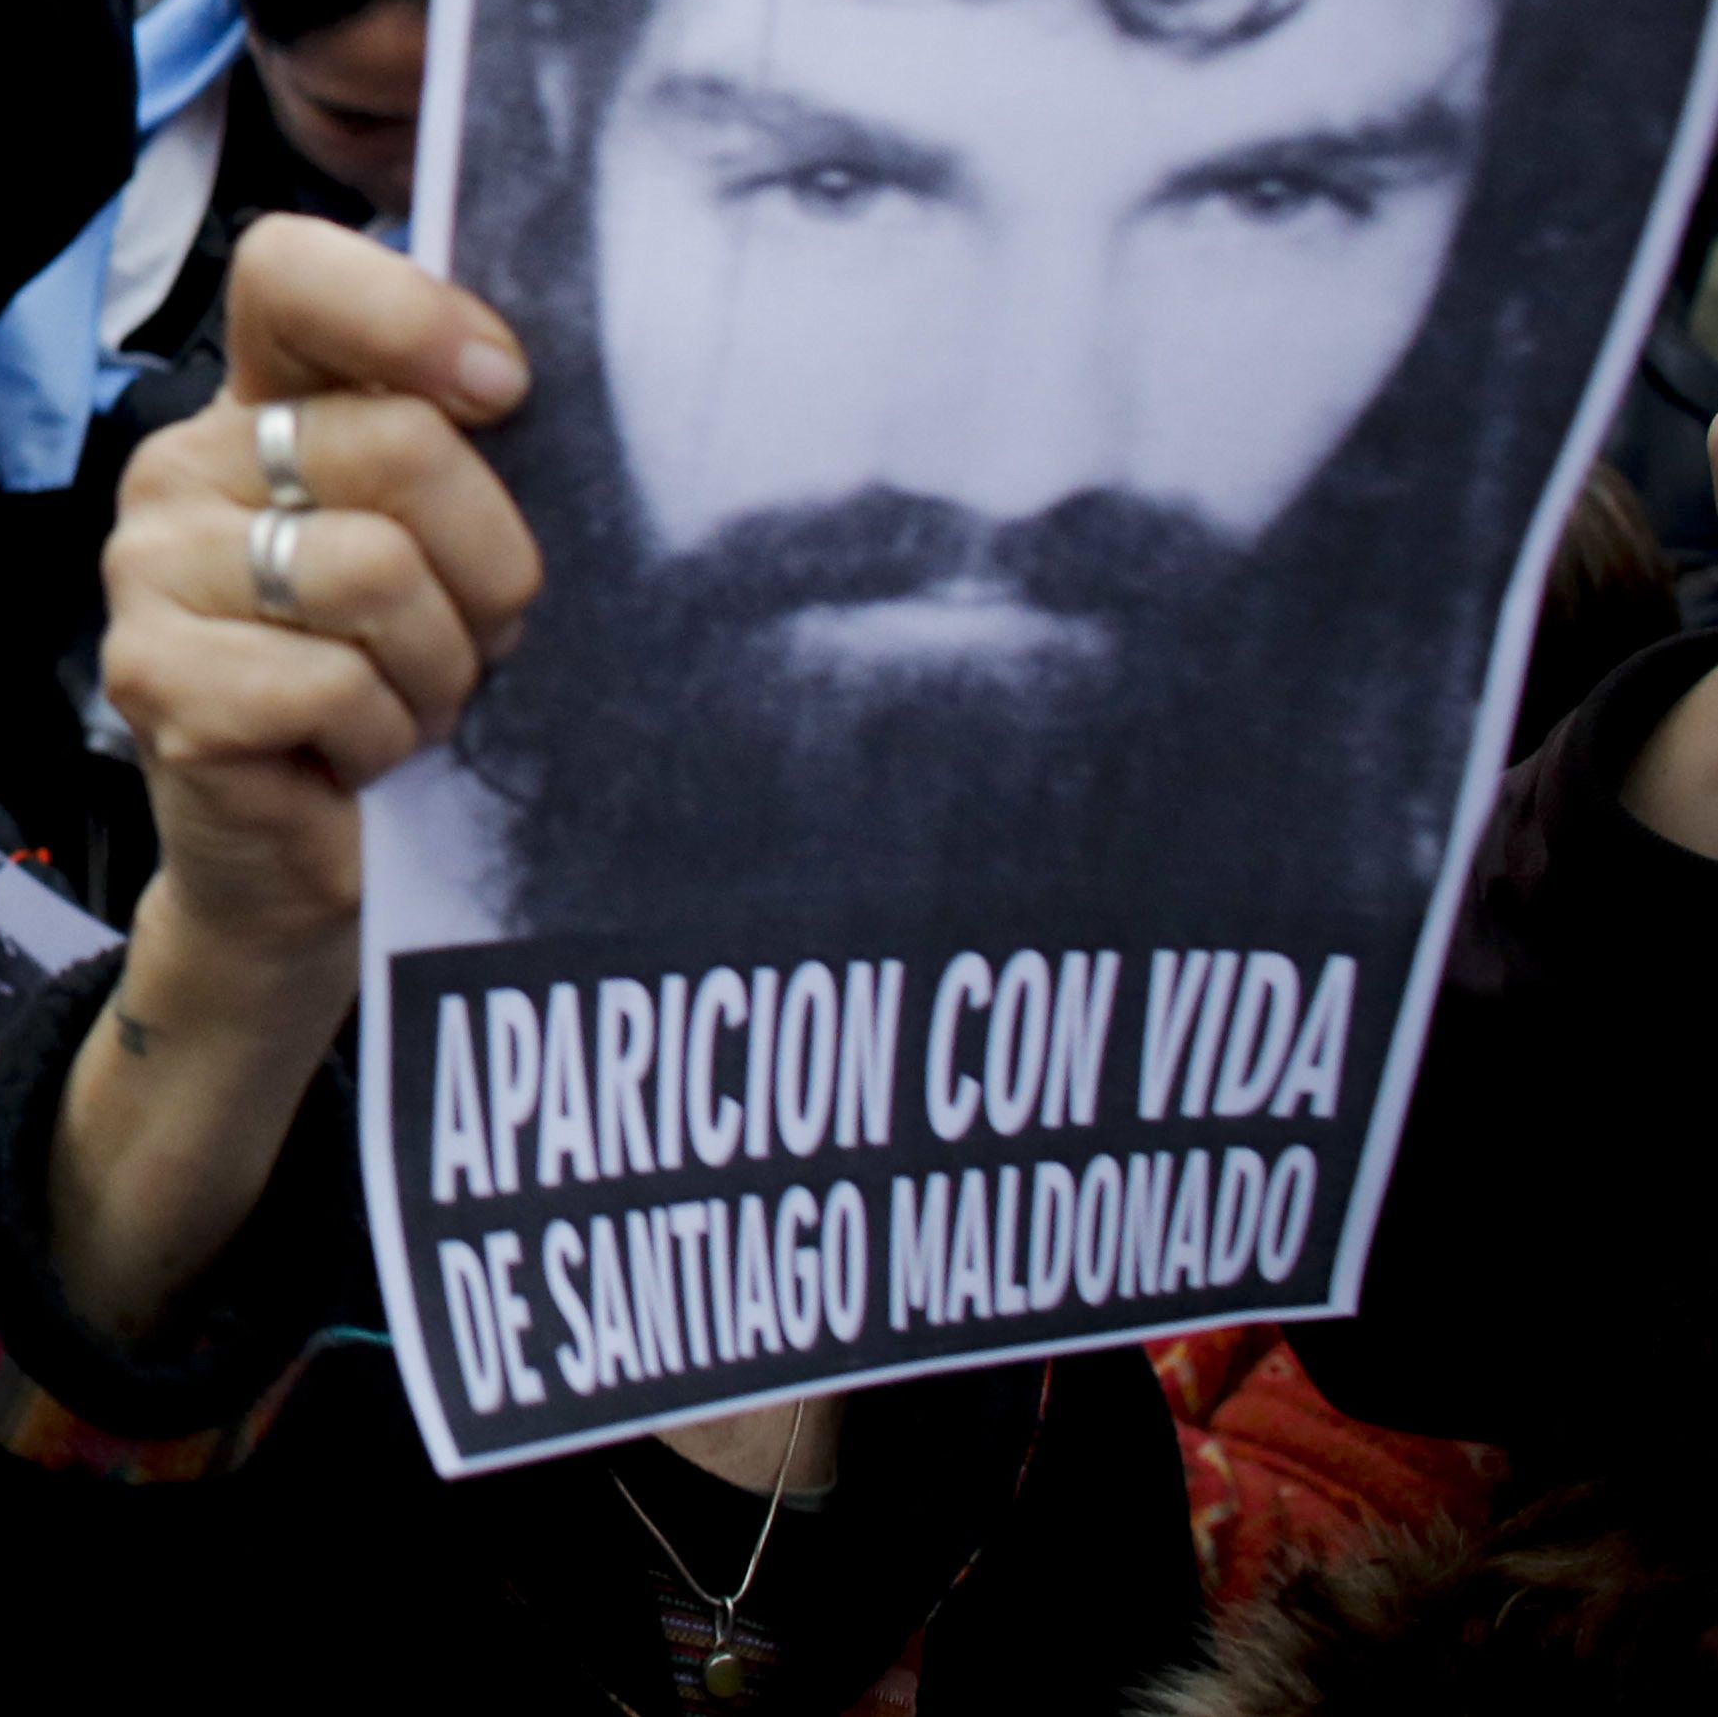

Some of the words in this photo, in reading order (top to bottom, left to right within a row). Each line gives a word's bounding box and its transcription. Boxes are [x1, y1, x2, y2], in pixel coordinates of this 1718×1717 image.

[432, 959, 904, 1203] APARICION
[926, 949, 1119, 1141] CON
[1139, 949, 1357, 1119] VIDA
[438, 1231, 545, 1414] DE
[541, 1180, 867, 1397] SANTIAGO
[890, 1144, 1317, 1330] MALDONADO
